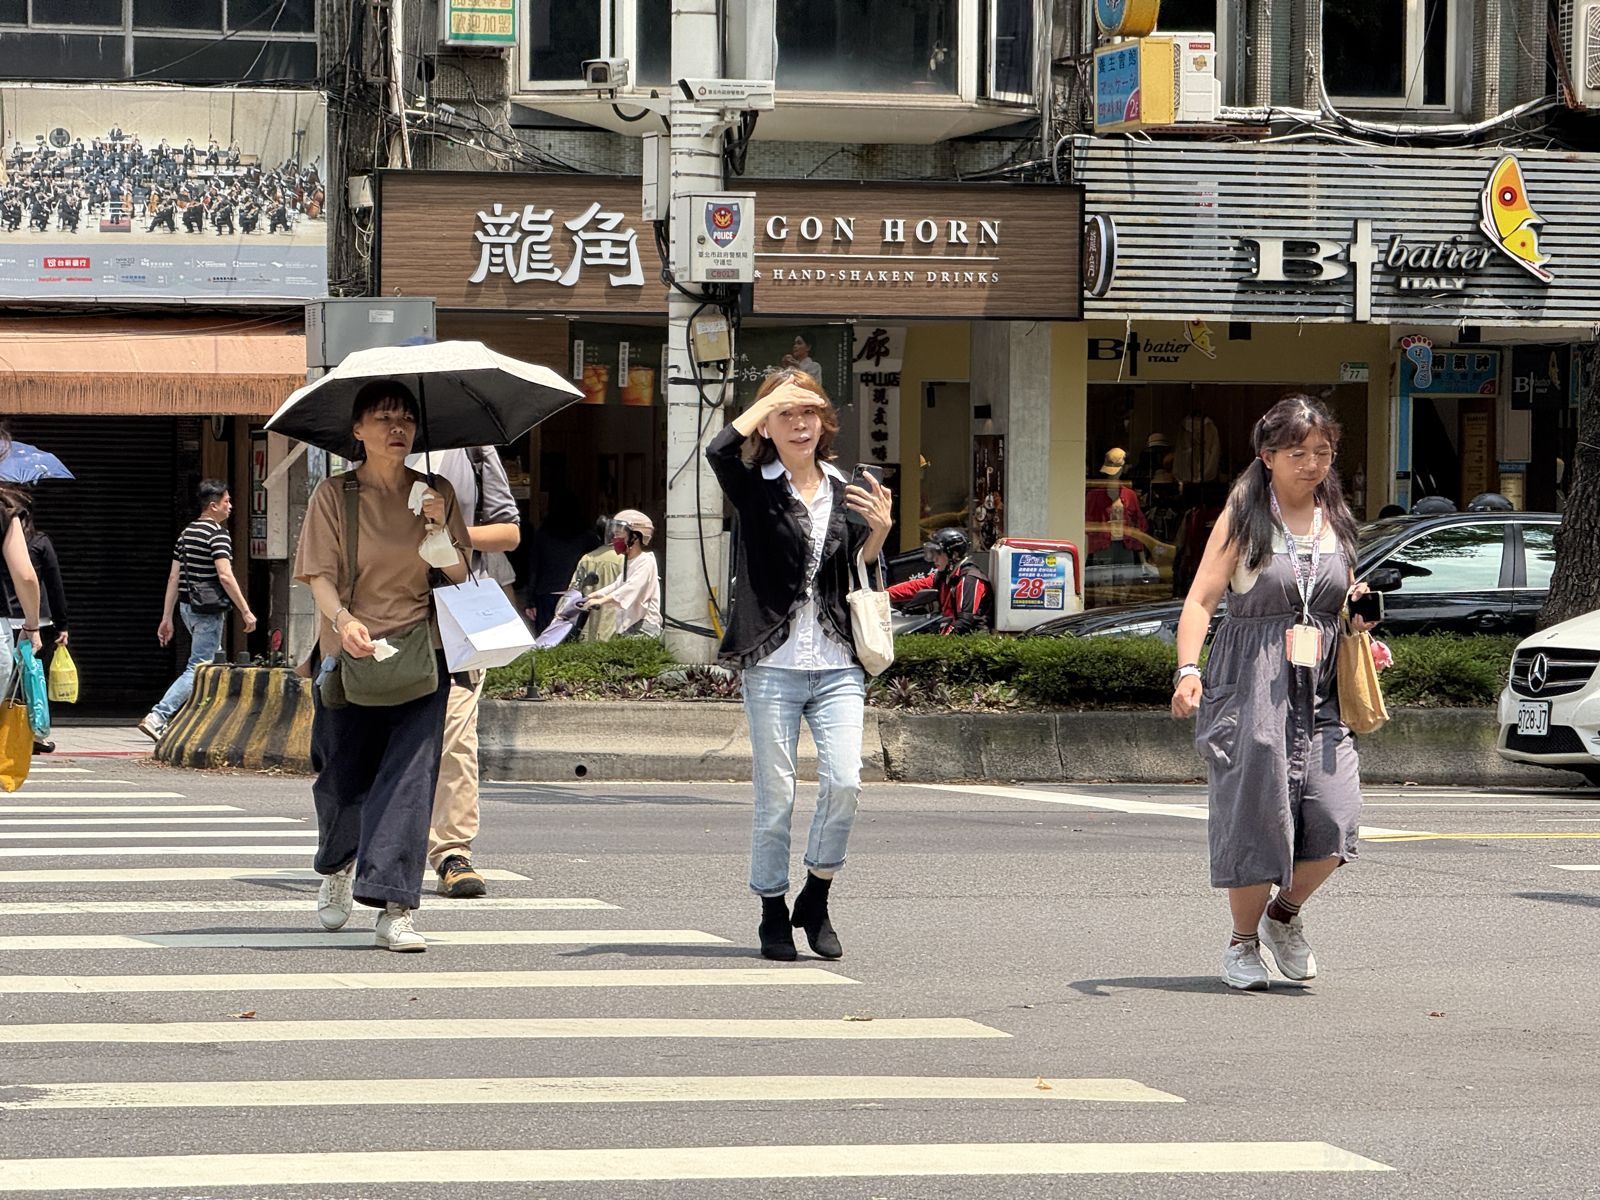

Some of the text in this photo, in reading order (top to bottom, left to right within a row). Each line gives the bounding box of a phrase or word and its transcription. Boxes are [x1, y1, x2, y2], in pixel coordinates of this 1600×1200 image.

[713, 231, 733, 240] POLICE
[883, 218, 1000, 245] HORN
[468, 202, 645, 286] 龍角
[1385, 234, 1497, 270] batier
[773, 269, 915, 283] HAND-SHAKEN
[927, 271, 999, 283] DRINKS
[1400, 276, 1466, 290] ITALY
[1143, 339, 1191, 353] batier
[860, 372, 900, 387] 中山店
[1350, 370, 1361, 379] 77
[1013, 578, 1045, 600] 28
